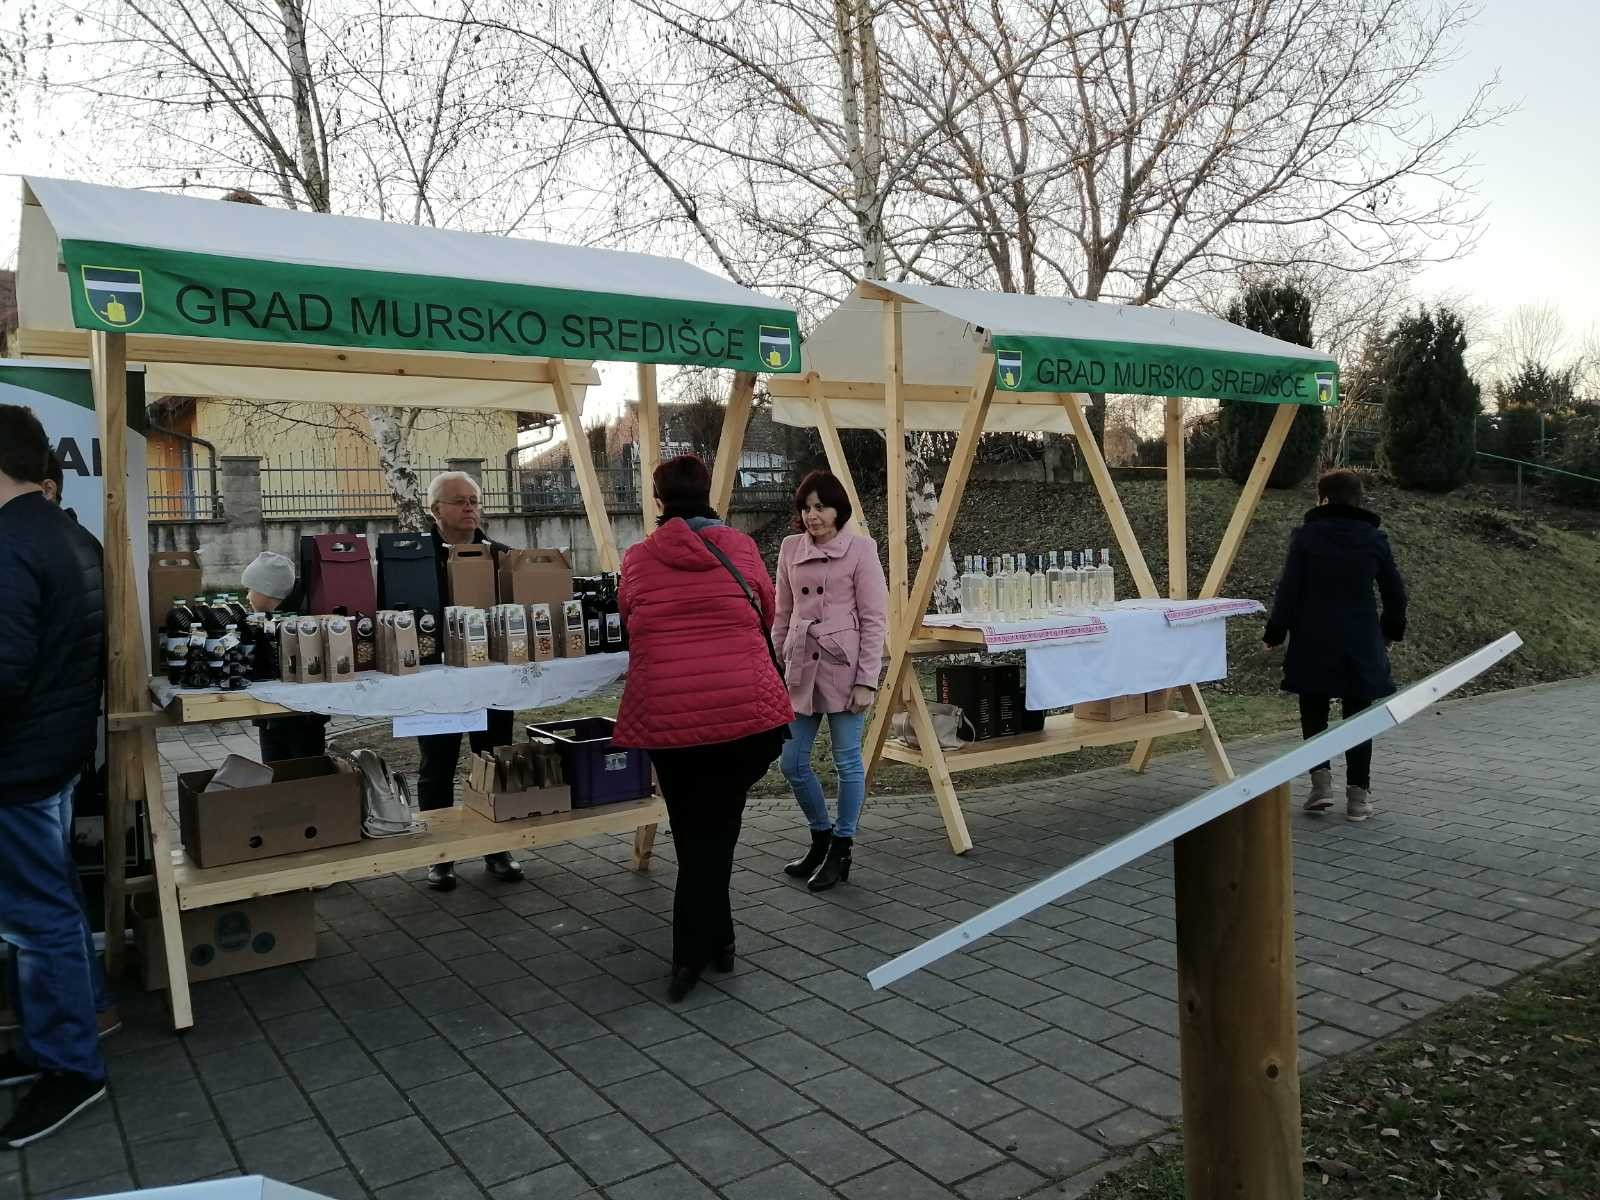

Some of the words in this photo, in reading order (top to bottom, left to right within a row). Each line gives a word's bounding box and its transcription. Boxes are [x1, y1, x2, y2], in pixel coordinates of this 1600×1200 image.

[176, 284, 333, 331] GRAD
[350, 297, 547, 346] MURSKO
[561, 314, 744, 361] SREDIŠĆE
[1037, 358, 1105, 386] GRAD
[1114, 361, 1204, 391] MURSKO
